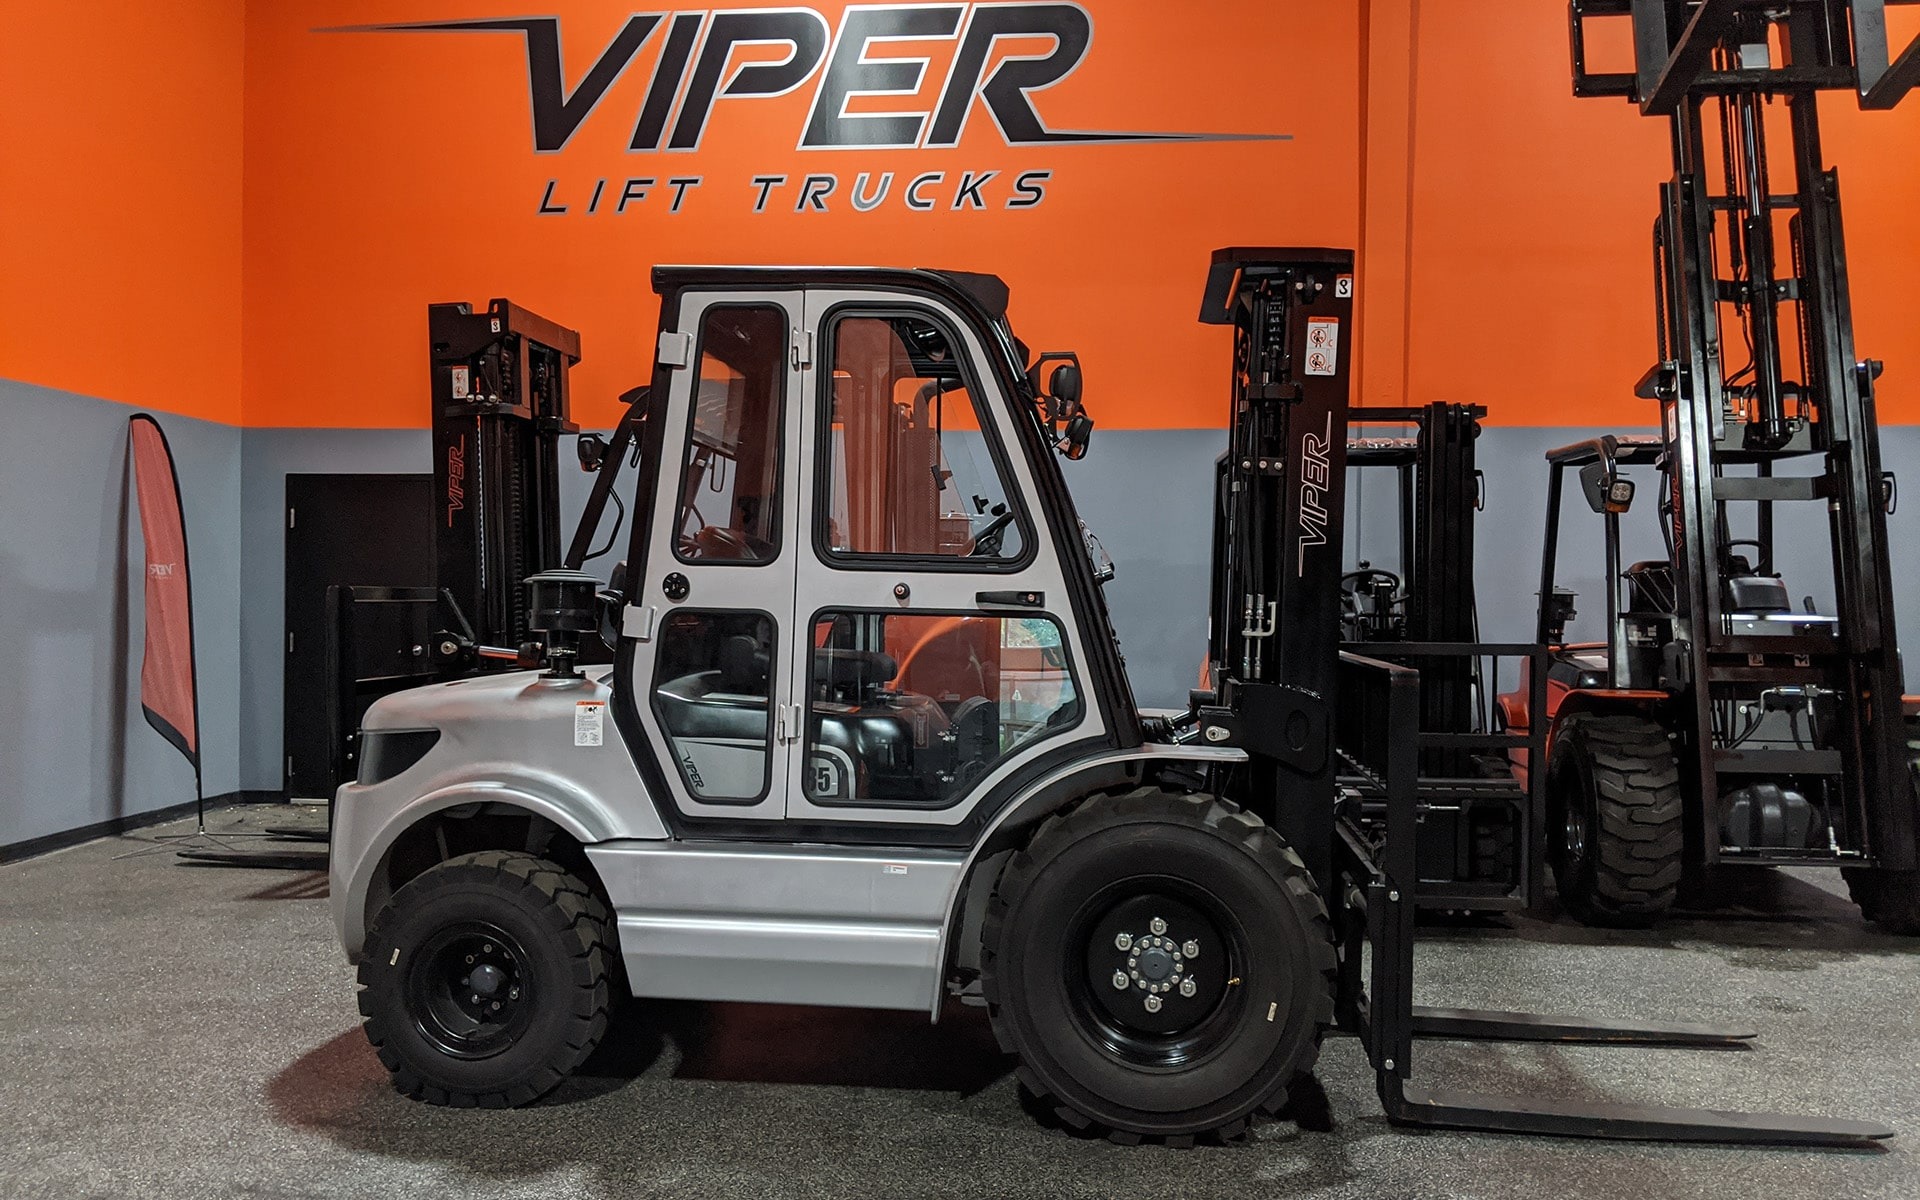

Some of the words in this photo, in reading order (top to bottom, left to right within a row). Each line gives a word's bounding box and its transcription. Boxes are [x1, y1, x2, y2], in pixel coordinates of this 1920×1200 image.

[524, 1, 1094, 154] VIPER
[537, 175, 704, 215] LIFT
[751, 169, 1054, 214] TRUCKS
[449, 446, 464, 510] VIPER
[1299, 432, 1330, 546] VIPER
[682, 755, 705, 789] VIPER
